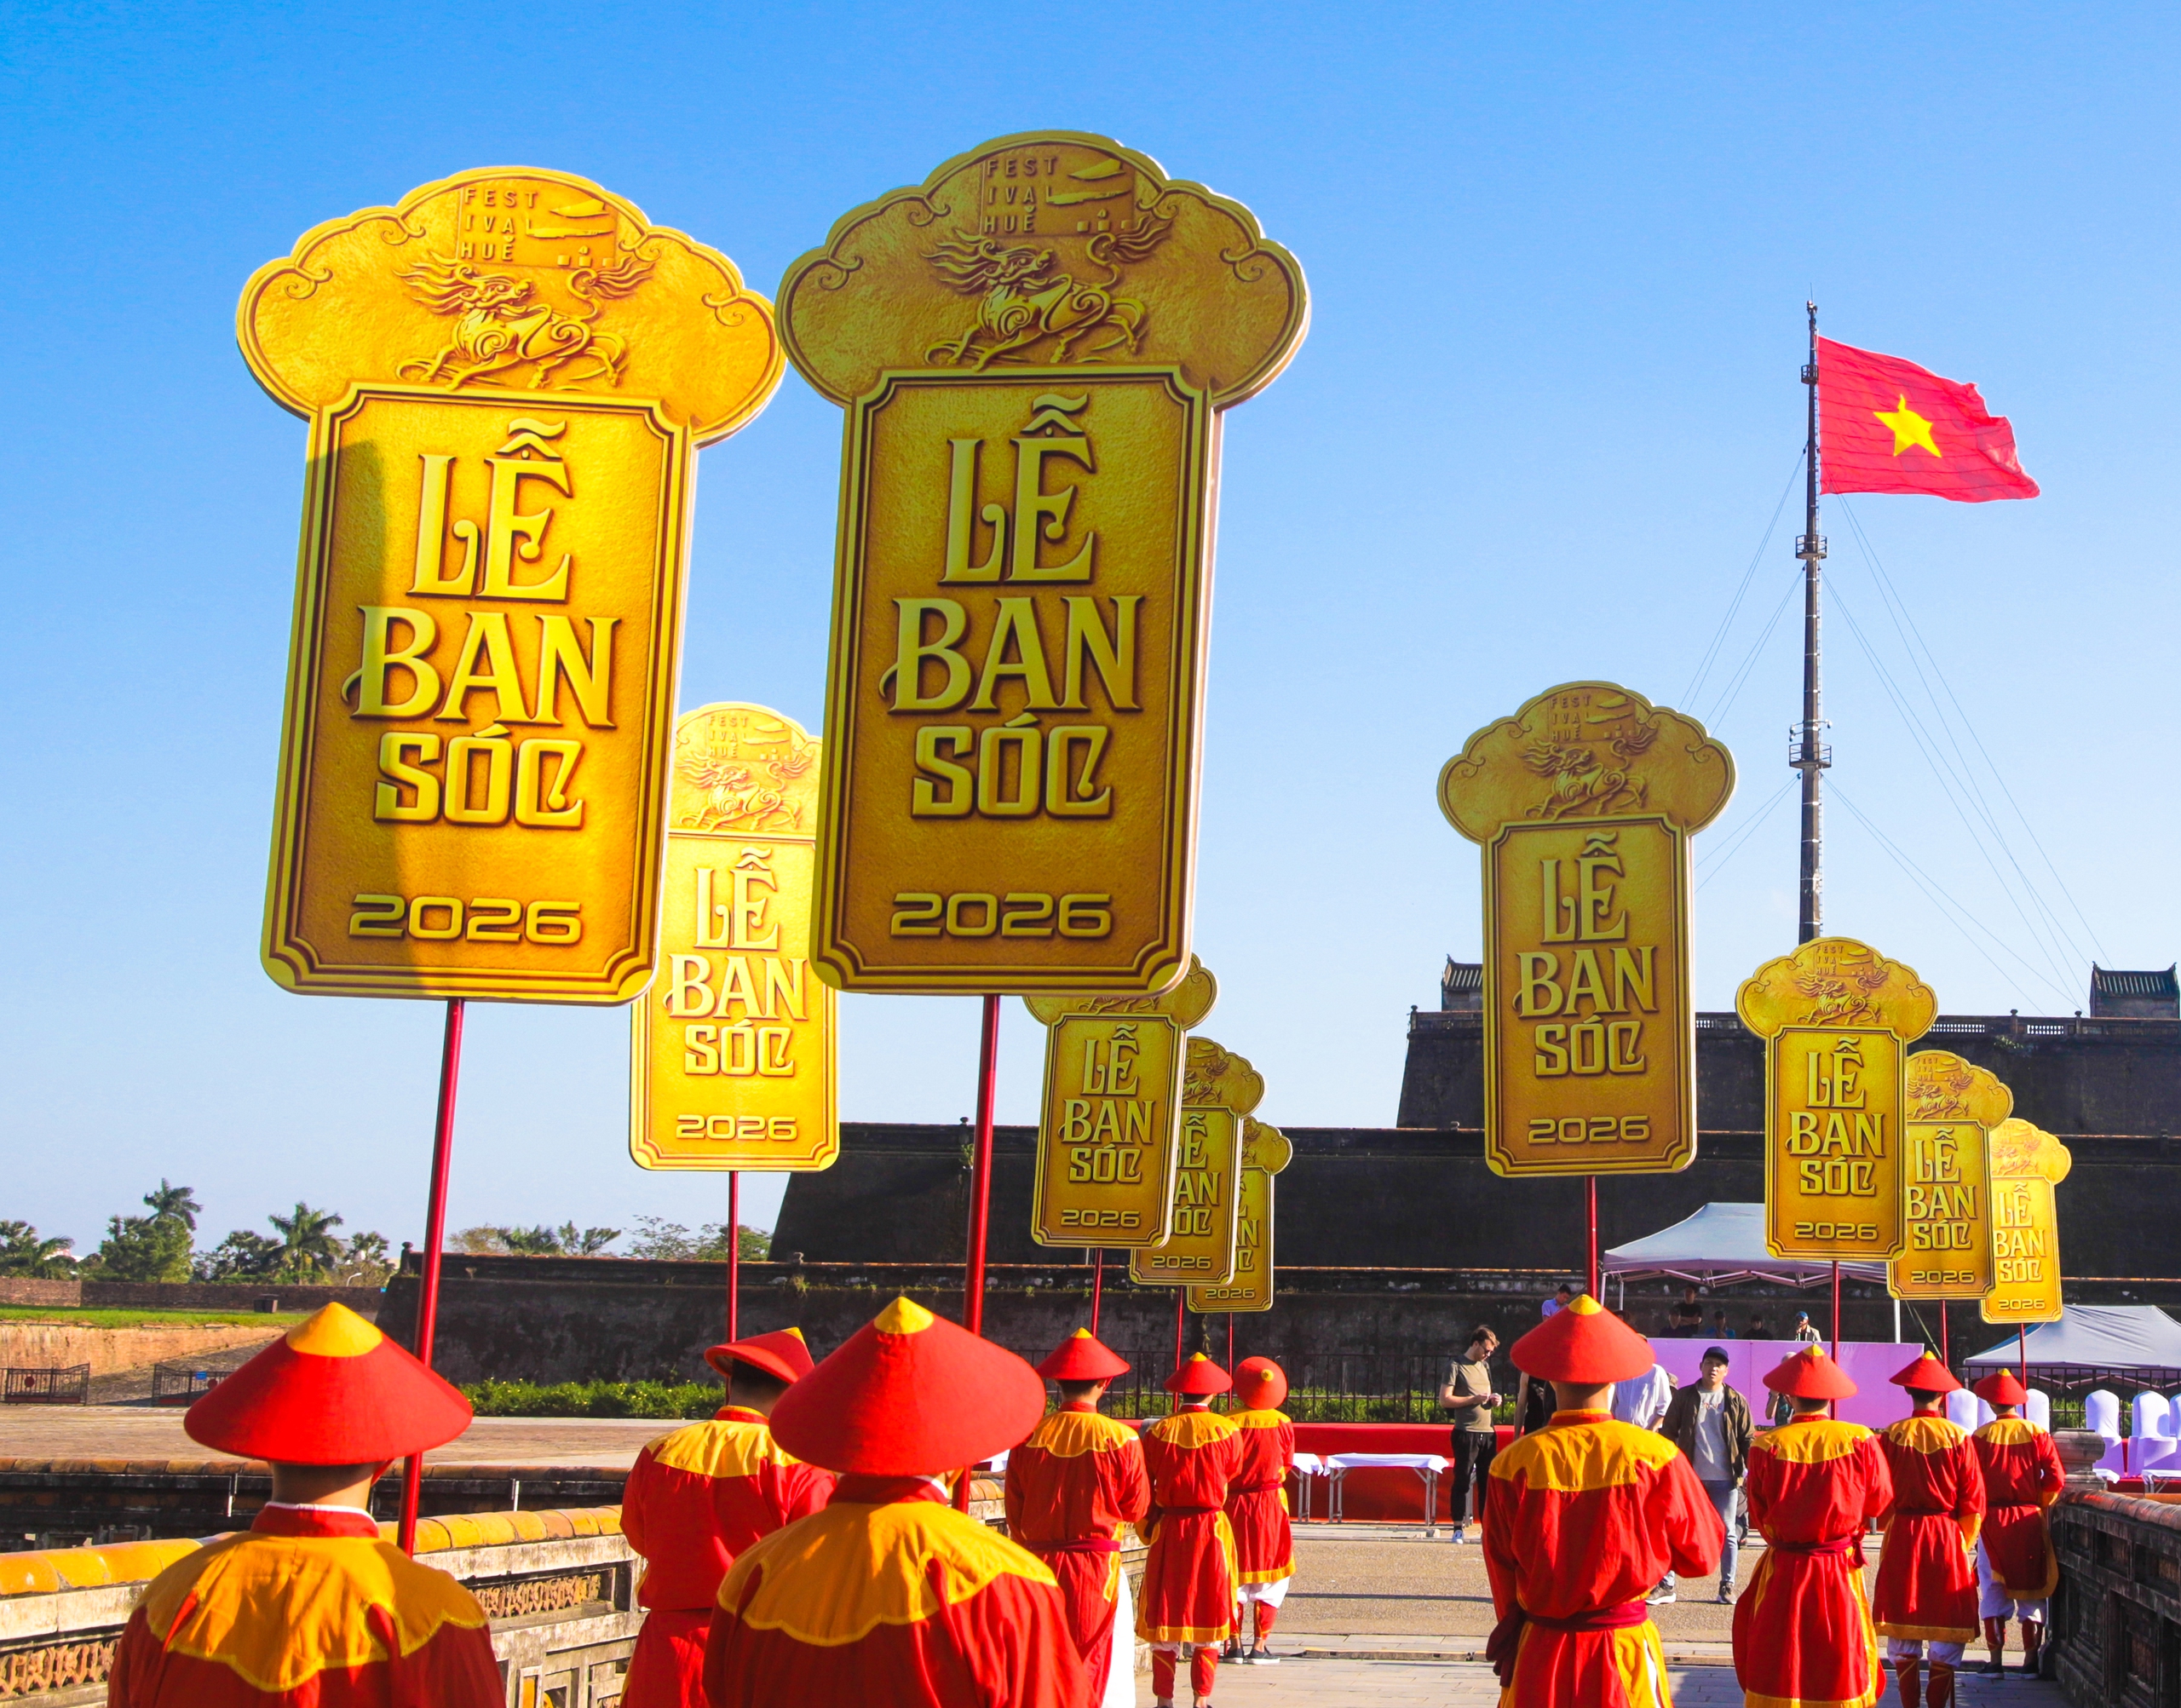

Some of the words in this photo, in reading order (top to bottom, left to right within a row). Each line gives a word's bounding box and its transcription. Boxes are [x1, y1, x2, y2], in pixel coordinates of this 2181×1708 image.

[987, 157, 1056, 177] FEST
[464, 187, 538, 208] FEST
[987, 185, 1056, 204] IVAL
[464, 215, 538, 236] IVAL
[938, 393, 1096, 586] LỄ
[406, 417, 573, 603] LỄ
[342, 605, 622, 729] BAN
[879, 595, 1144, 716] BAN
[709, 716, 749, 727] FEST
[1551, 695, 1591, 709] FEST
[373, 723, 584, 831] SÓC
[911, 712, 1113, 819] SÓC
[693, 847, 778, 951] LỄ
[1539, 831, 1626, 944] LỄ
[348, 894, 582, 945] 2026
[891, 892, 1111, 937] 2026
[663, 953, 809, 1021] BAN
[1512, 946, 1659, 1019] BAN
[684, 1019, 795, 1078] SÓC
[1080, 1024, 1139, 1096] LỄ
[1534, 1015, 1645, 1078] SÓC
[1806, 1037, 1865, 1108] LỄ
[676, 1114, 798, 1141] 2026
[1058, 1099, 1155, 1144] BAN
[1177, 1113, 1208, 1169] Ễ
[1528, 1115, 1650, 1144] 2026
[1785, 1111, 1885, 1158] BAN
[1068, 1143, 1142, 1183] SÓC
[1913, 1127, 1959, 1183] LỄ
[1173, 1171, 1220, 1206] AN
[1799, 1156, 1876, 1196] SÓC
[1061, 1209, 1140, 1228] 2026
[1171, 1205, 1211, 1235] ÓC
[1908, 1185, 1977, 1220] BAN
[1998, 1182, 2034, 1228] LỄ
[1794, 1222, 1878, 1240] 2026
[1913, 1219, 1972, 1250] SÓC
[1994, 1229, 2046, 1258] BAN
[1151, 1256, 1211, 1270] 2026
[1911, 1269, 1974, 1284] 2026
[1999, 1257, 2043, 1283] SÓC
[1205, 1288, 1255, 1299] 2026
[1998, 1298, 2046, 1310] 2026
